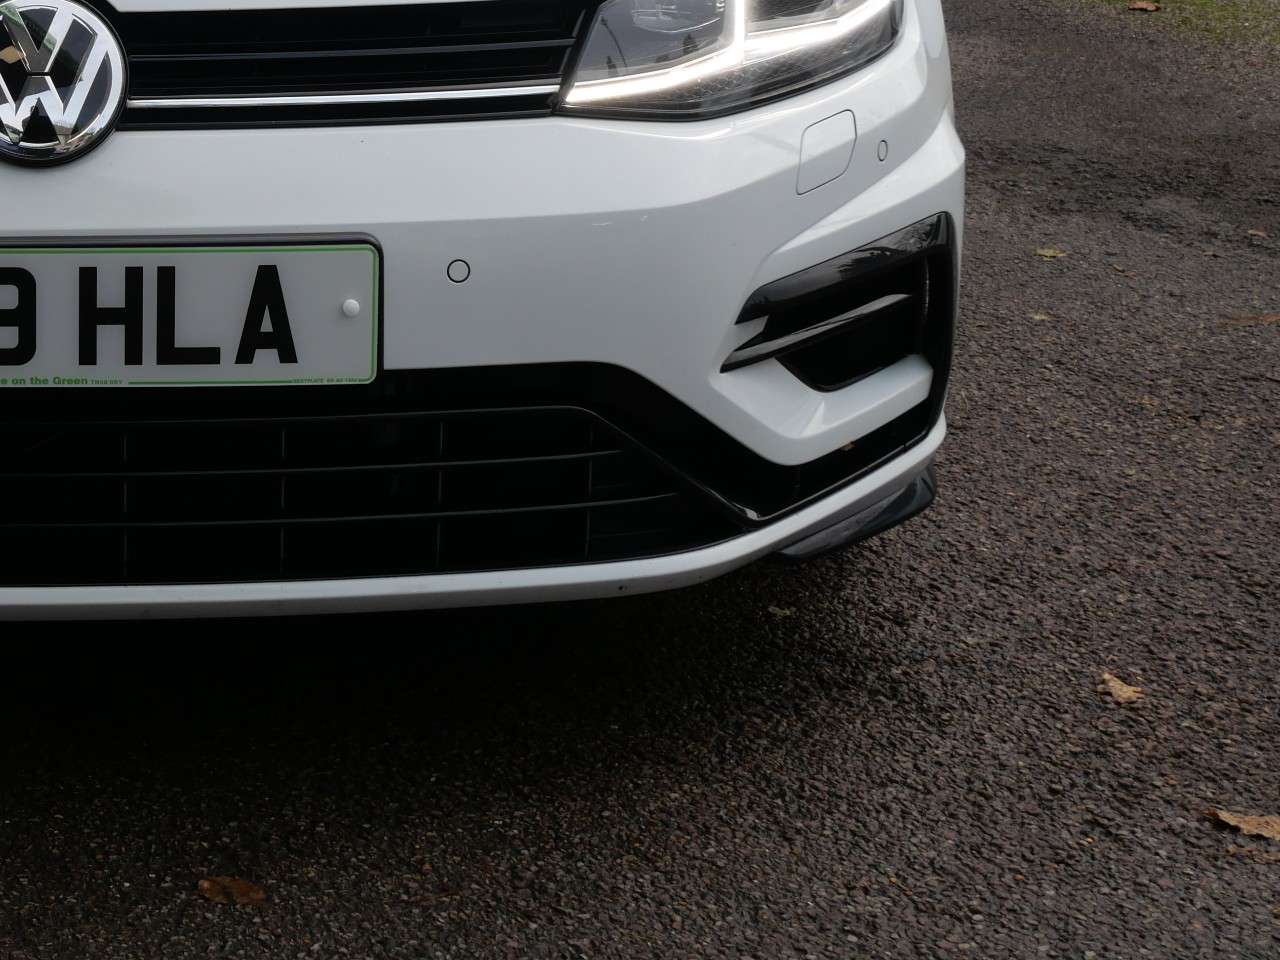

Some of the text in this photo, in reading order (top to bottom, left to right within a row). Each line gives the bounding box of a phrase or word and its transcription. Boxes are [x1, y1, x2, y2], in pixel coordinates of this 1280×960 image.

[78, 264, 299, 366] HLA
[30, 376, 49, 385] the
[53, 376, 88, 385] Green
